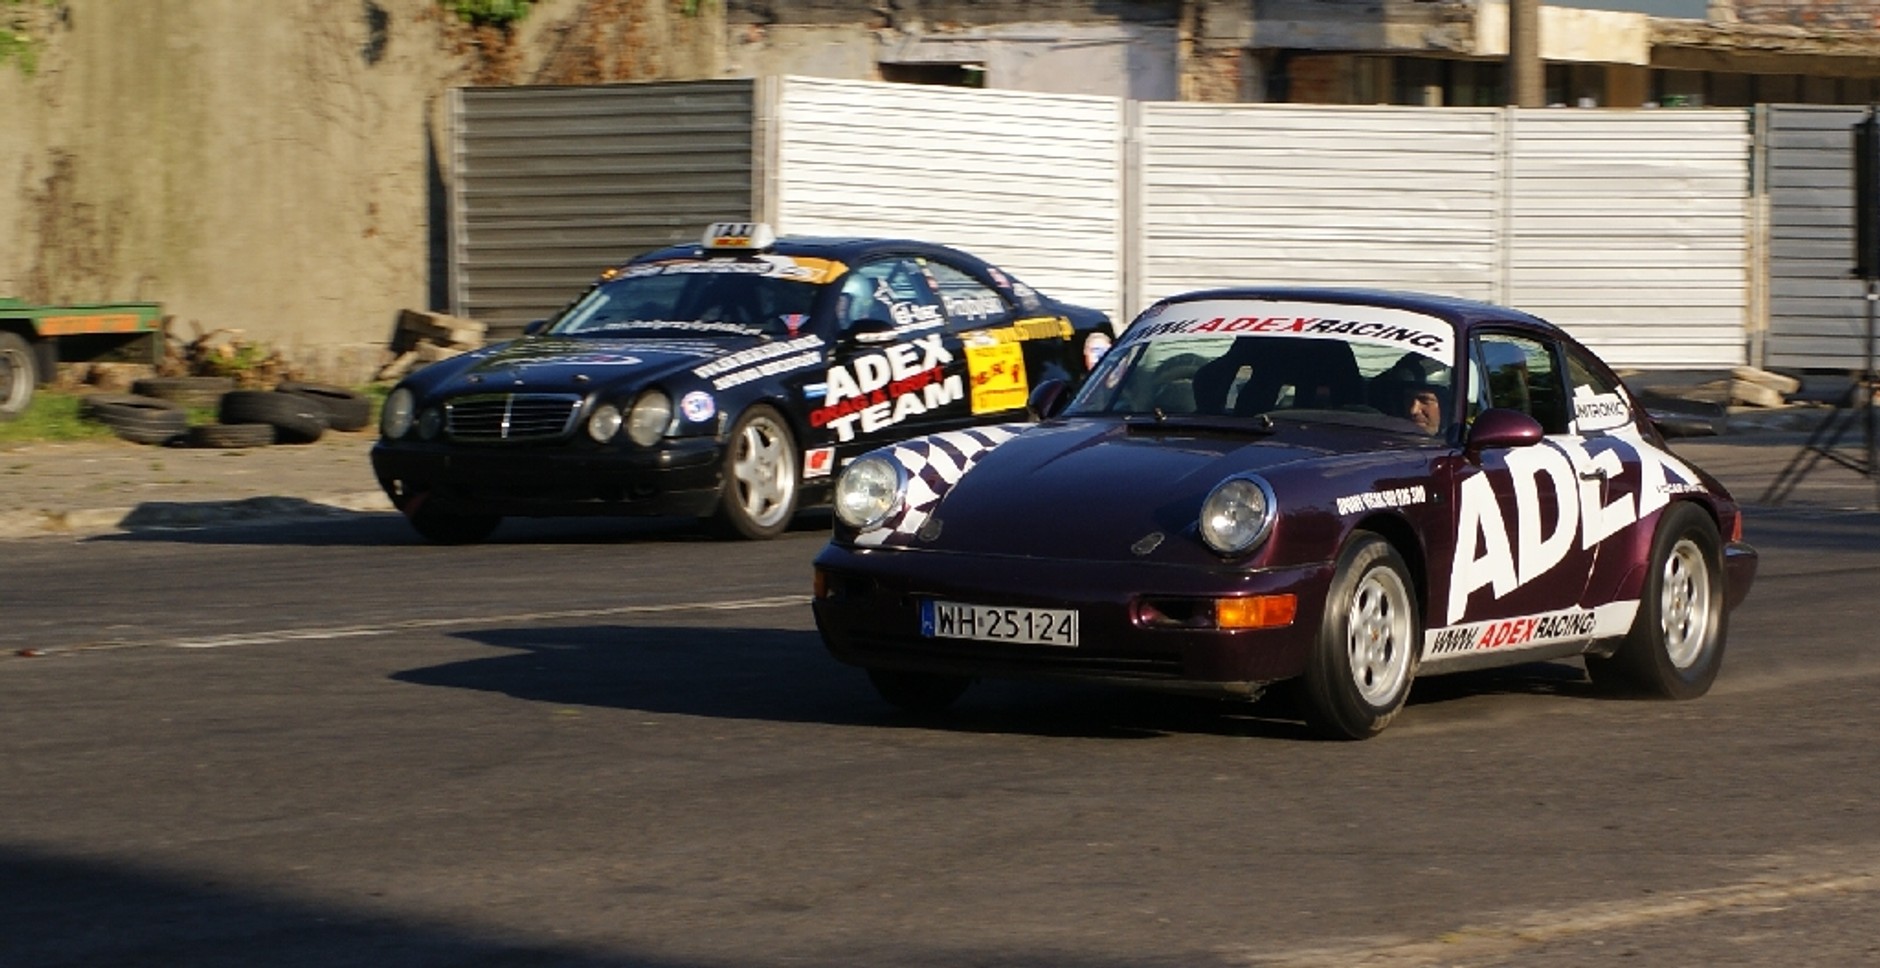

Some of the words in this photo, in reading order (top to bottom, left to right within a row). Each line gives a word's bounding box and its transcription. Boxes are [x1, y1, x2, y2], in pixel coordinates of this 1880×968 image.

[713, 223, 757, 237] TAXI
[824, 333, 953, 407] ADEX
[826, 374, 964, 443] TEAM
